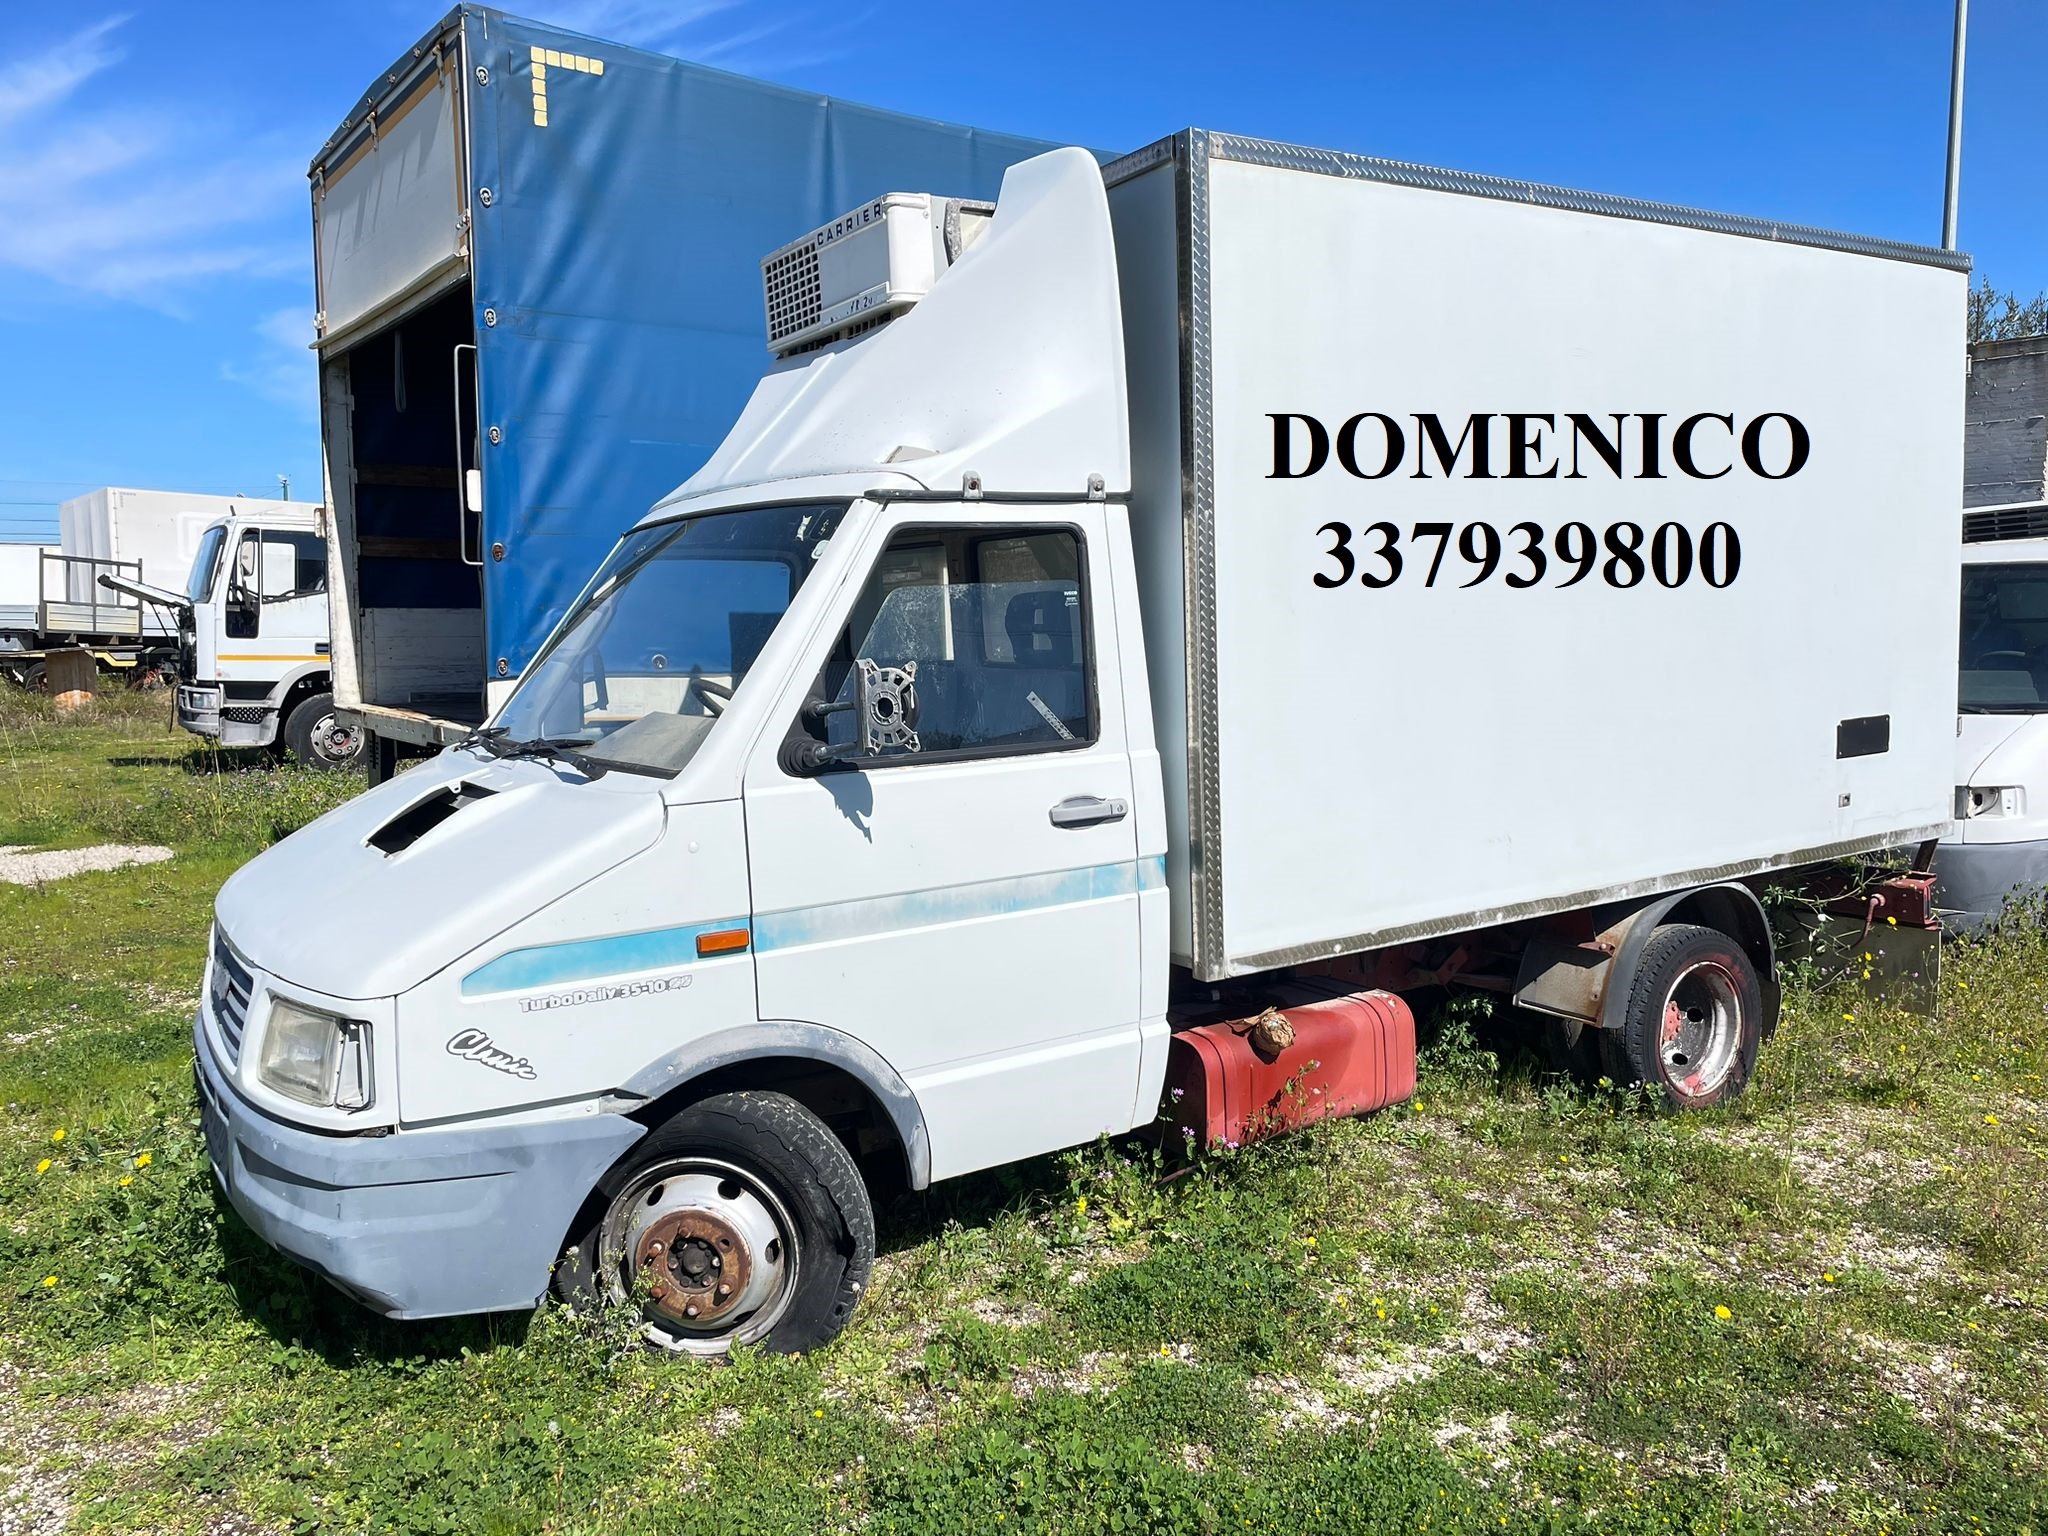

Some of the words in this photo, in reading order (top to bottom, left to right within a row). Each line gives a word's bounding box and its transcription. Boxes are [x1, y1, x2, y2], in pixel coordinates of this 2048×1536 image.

[817, 203, 882, 246] CARRIER
[519, 987, 616, 1013] TurboDaily
[619, 978, 666, 999] 35-10
